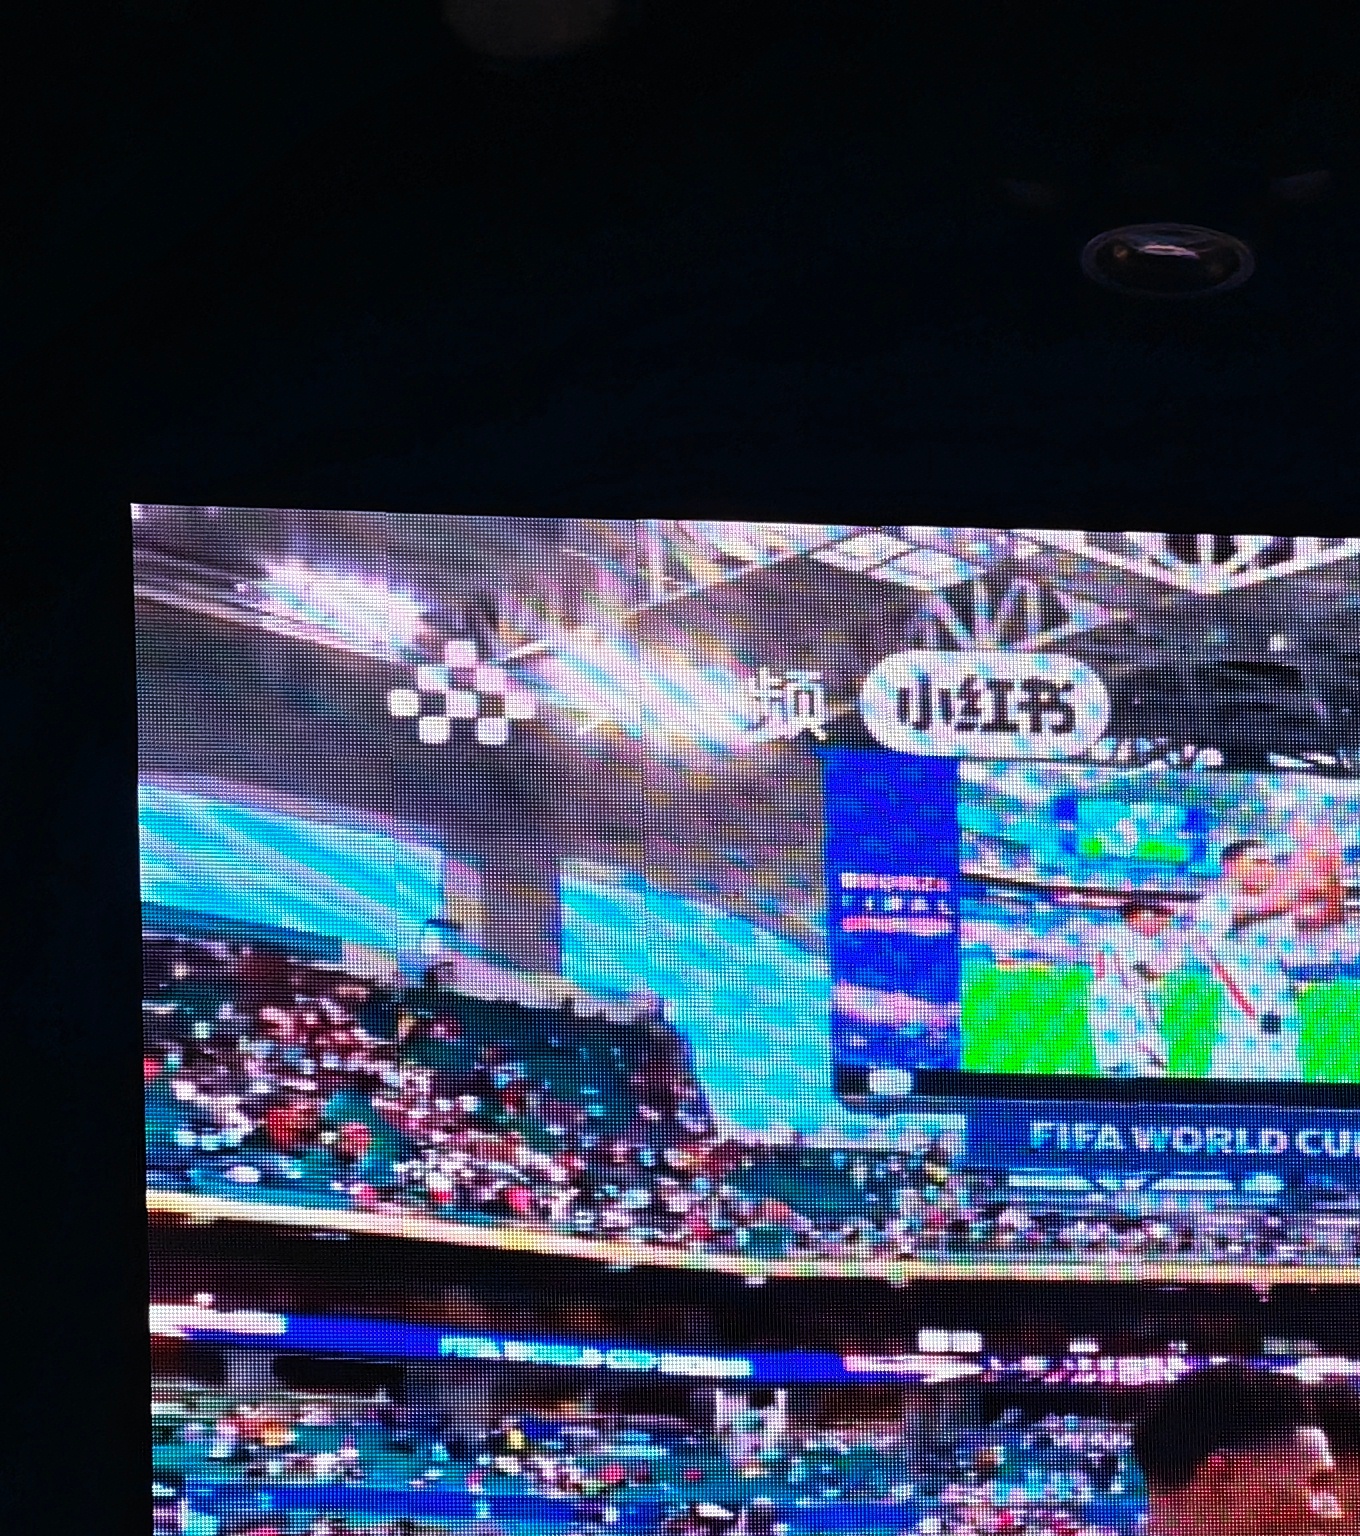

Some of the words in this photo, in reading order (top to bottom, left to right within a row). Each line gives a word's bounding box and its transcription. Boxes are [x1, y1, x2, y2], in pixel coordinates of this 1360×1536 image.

[895, 673, 1077, 734] 小红书
[1030, 1120, 1124, 1152] FIFA
[1132, 1123, 1287, 1157] WORLD
